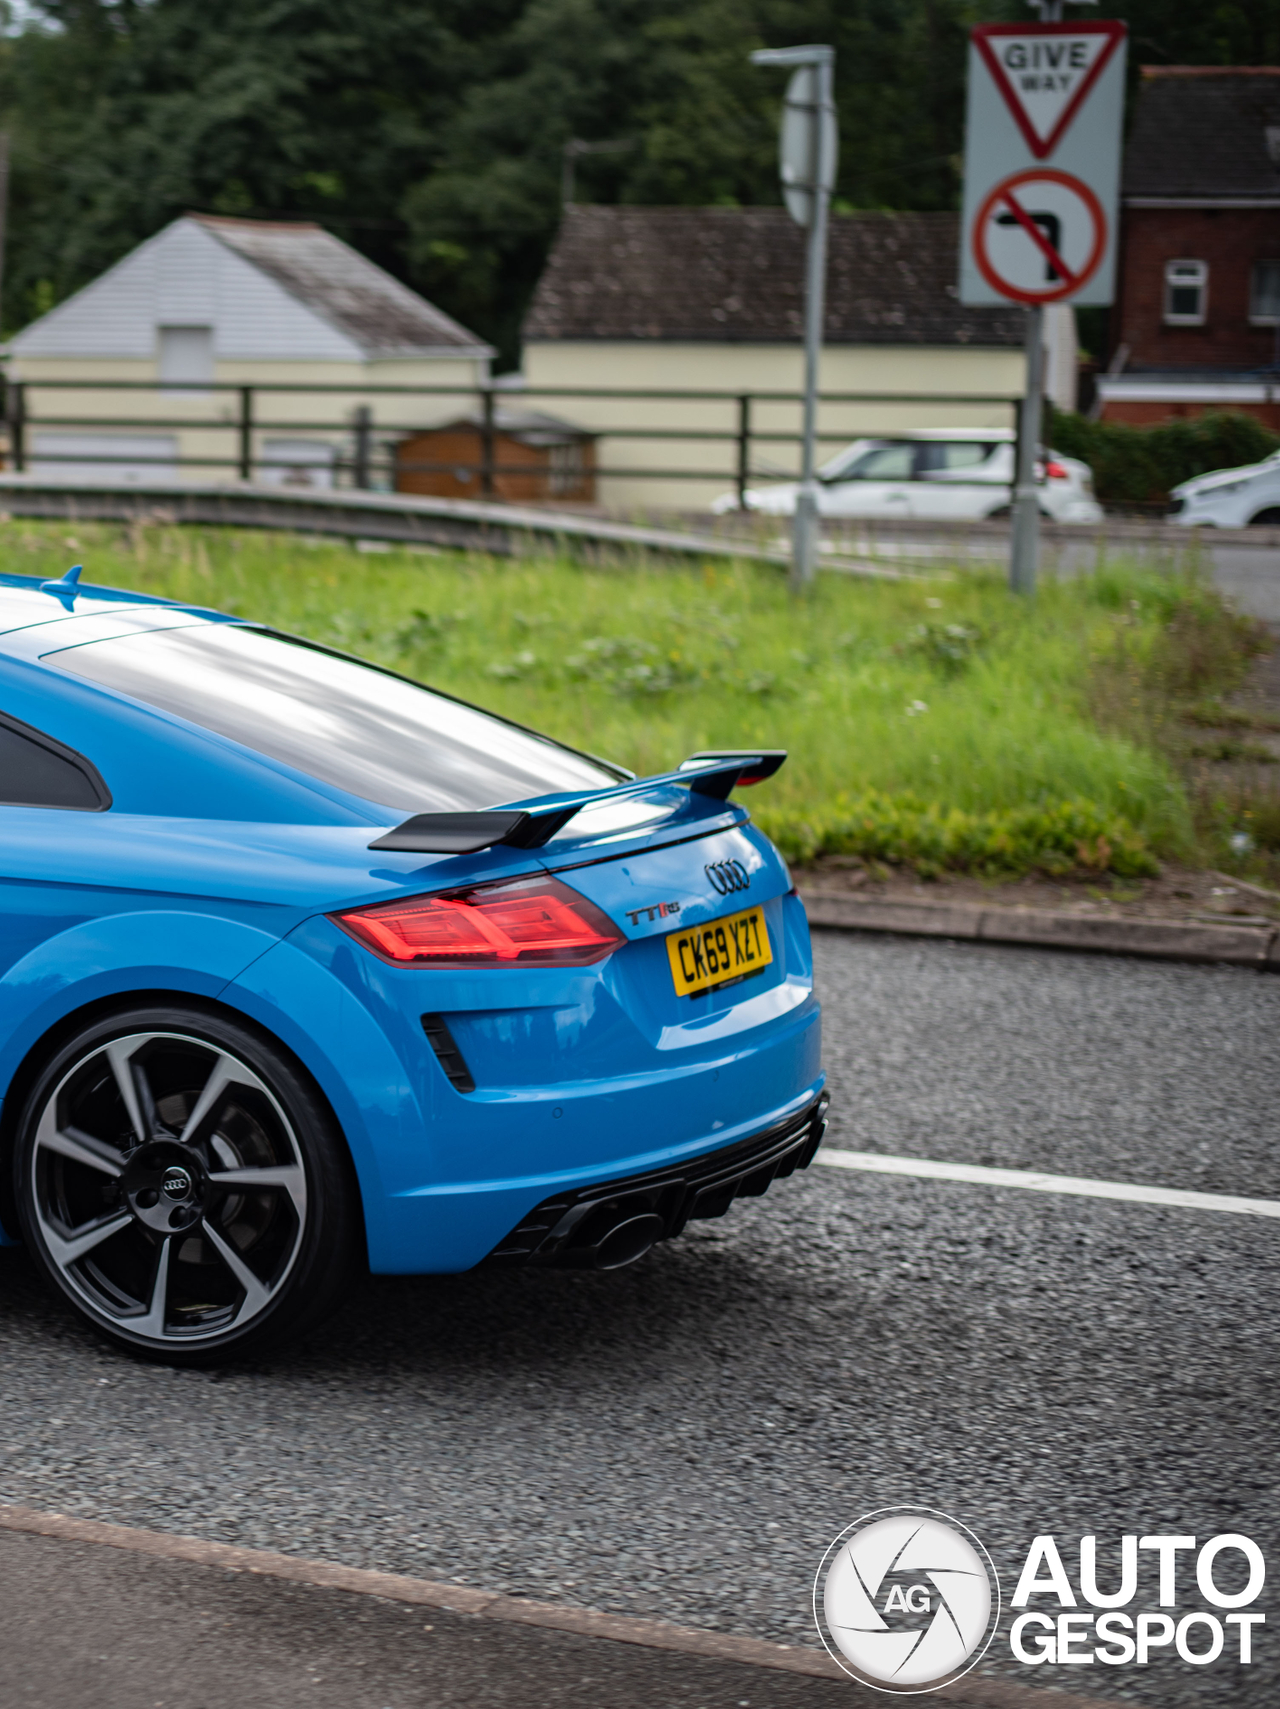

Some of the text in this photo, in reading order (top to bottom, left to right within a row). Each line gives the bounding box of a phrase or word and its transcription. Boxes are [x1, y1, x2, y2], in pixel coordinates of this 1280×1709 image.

[1005, 42, 1087, 69] GIVE
[1022, 74, 1071, 91] WAY
[677, 914, 762, 983] CK69 XZT
